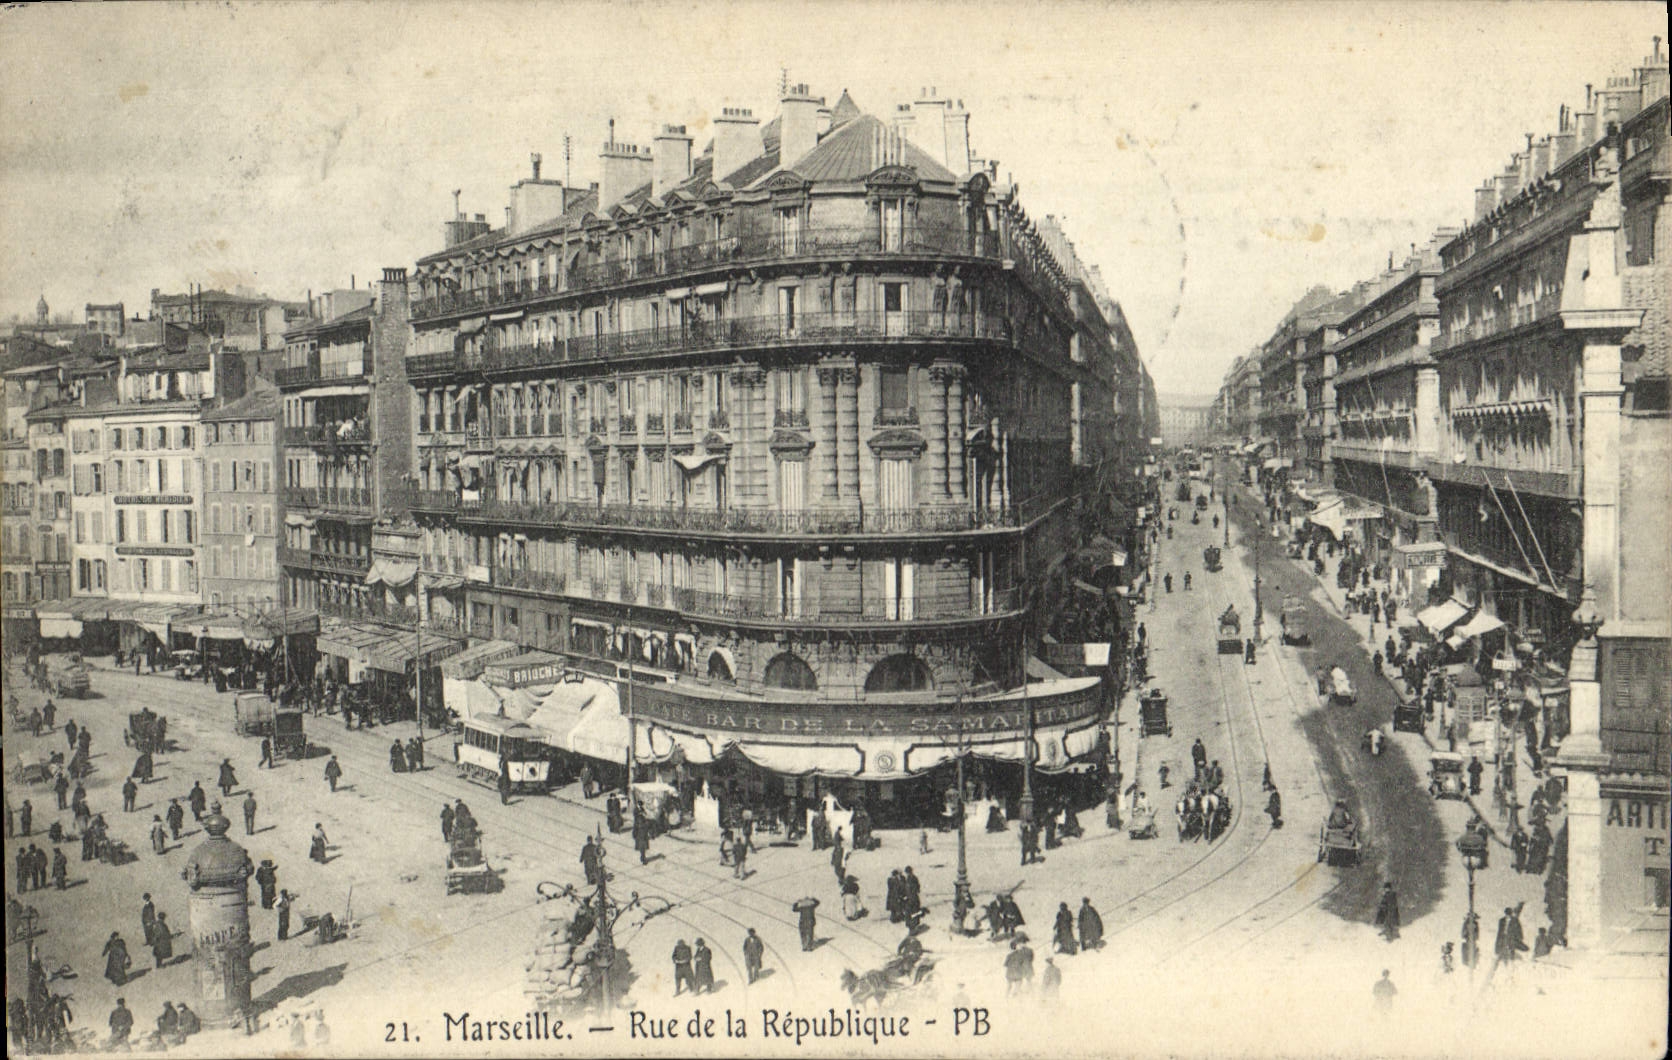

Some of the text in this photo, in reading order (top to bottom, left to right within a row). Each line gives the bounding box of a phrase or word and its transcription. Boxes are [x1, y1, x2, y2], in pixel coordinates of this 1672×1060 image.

[706, 713, 761, 730] BAR
[781, 718, 823, 732] DE
[846, 718, 893, 732] LA
